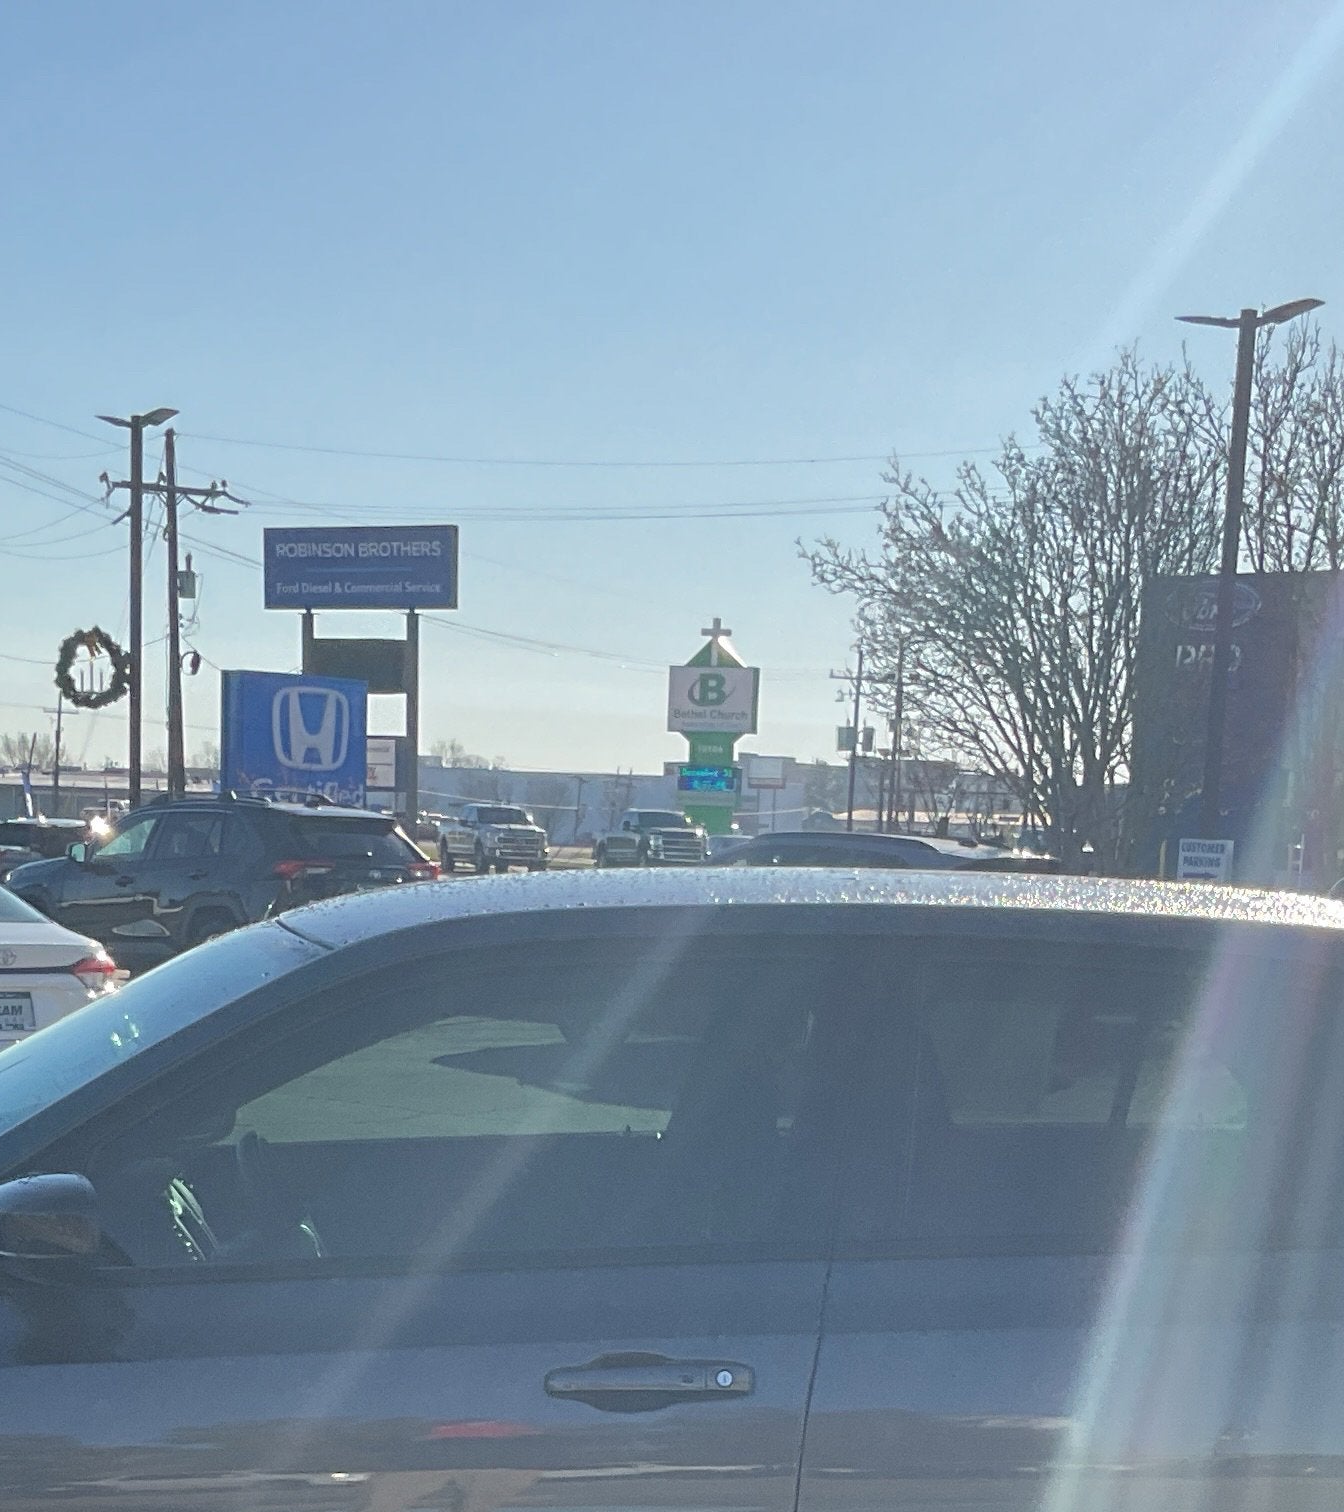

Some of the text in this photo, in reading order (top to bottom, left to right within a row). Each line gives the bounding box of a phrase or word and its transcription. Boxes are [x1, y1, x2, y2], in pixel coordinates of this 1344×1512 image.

[276, 541, 441, 558] ROBINSON BROTHERS
[276, 582, 299, 594] Ford
[302, 581, 332, 593] Diesel
[334, 583, 342, 593] &
[344, 581, 402, 593] Commercial
[673, 709, 748, 720] Bethel Church
[1181, 842, 1225, 854] CUSTOMER
[1182, 855, 1221, 867] PARKING
